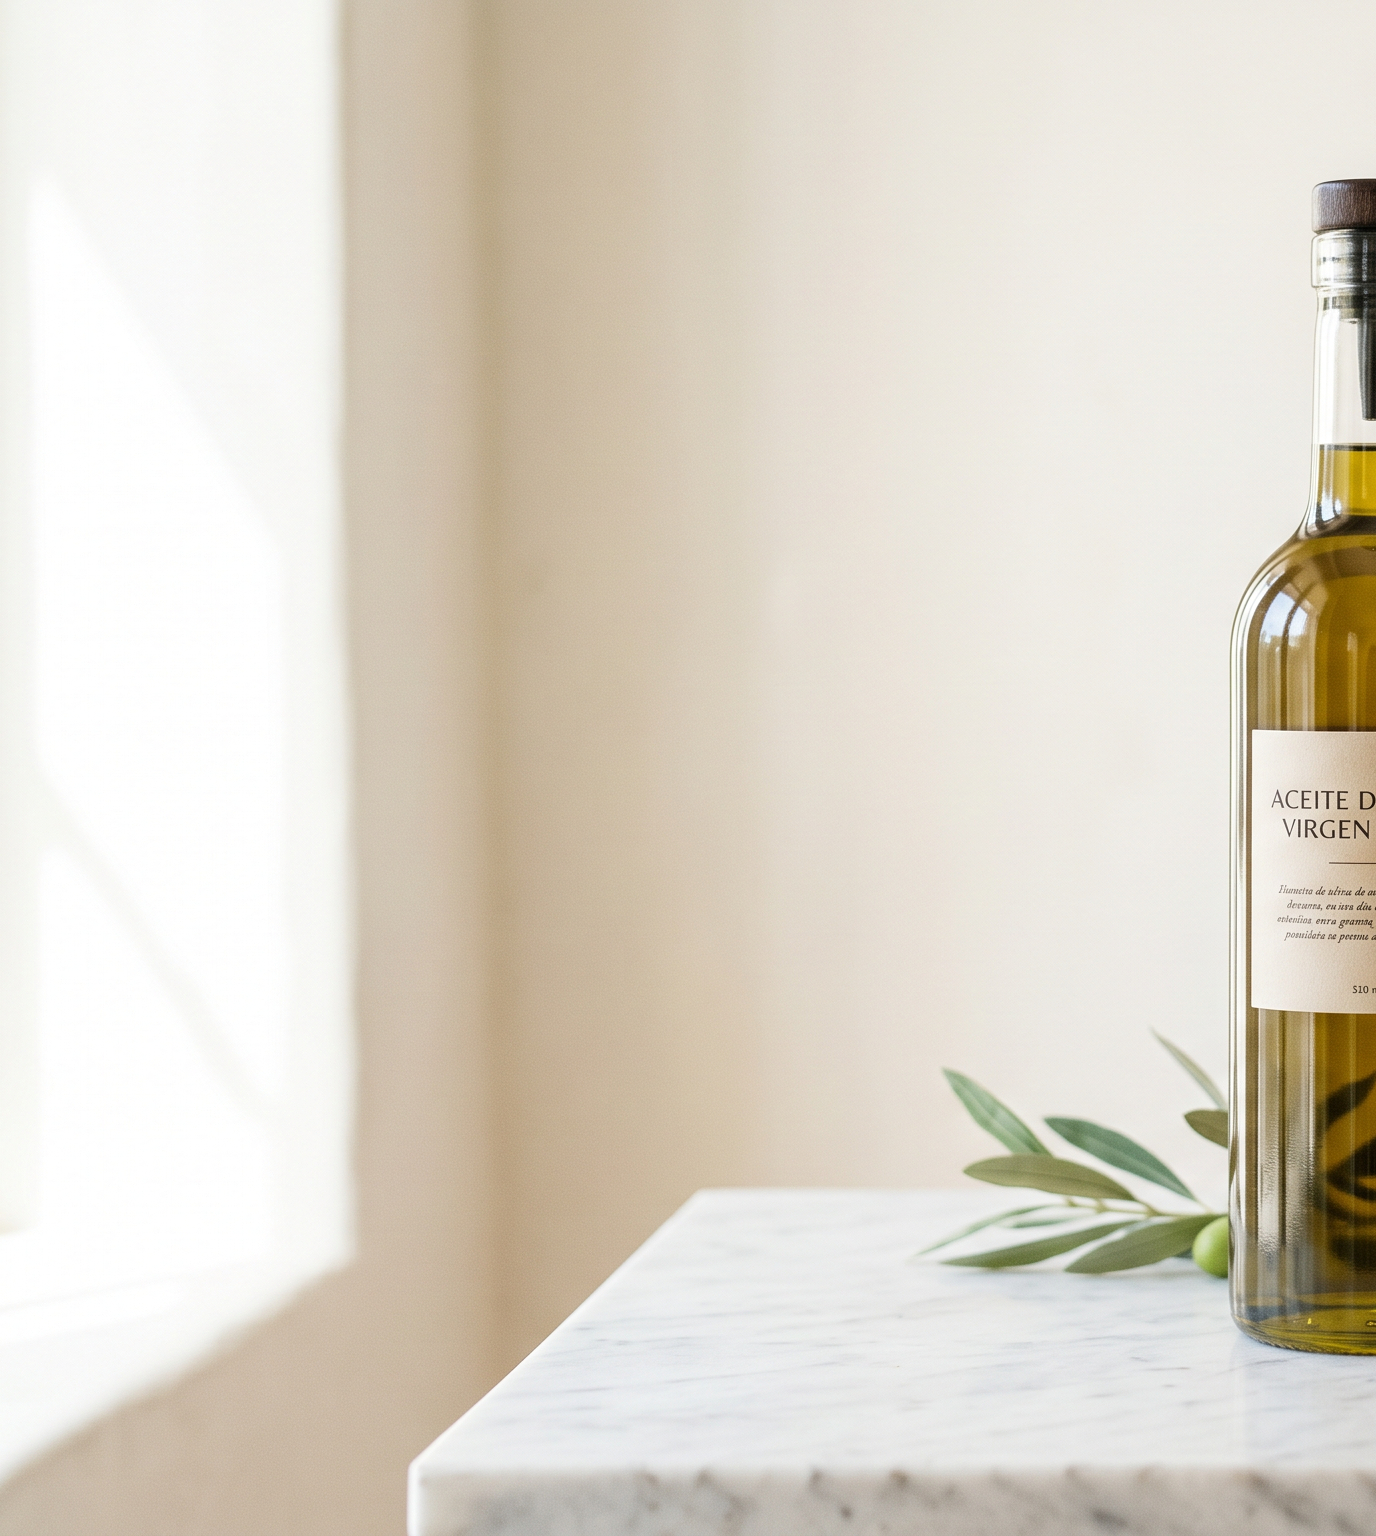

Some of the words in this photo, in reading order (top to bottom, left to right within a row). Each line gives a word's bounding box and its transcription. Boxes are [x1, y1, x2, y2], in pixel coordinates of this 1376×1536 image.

[1271, 789, 1349, 810] ACEITE
[1282, 818, 1370, 840] VIRGEN
[1315, 886, 1326, 895] de
[1354, 886, 1366, 896] de
